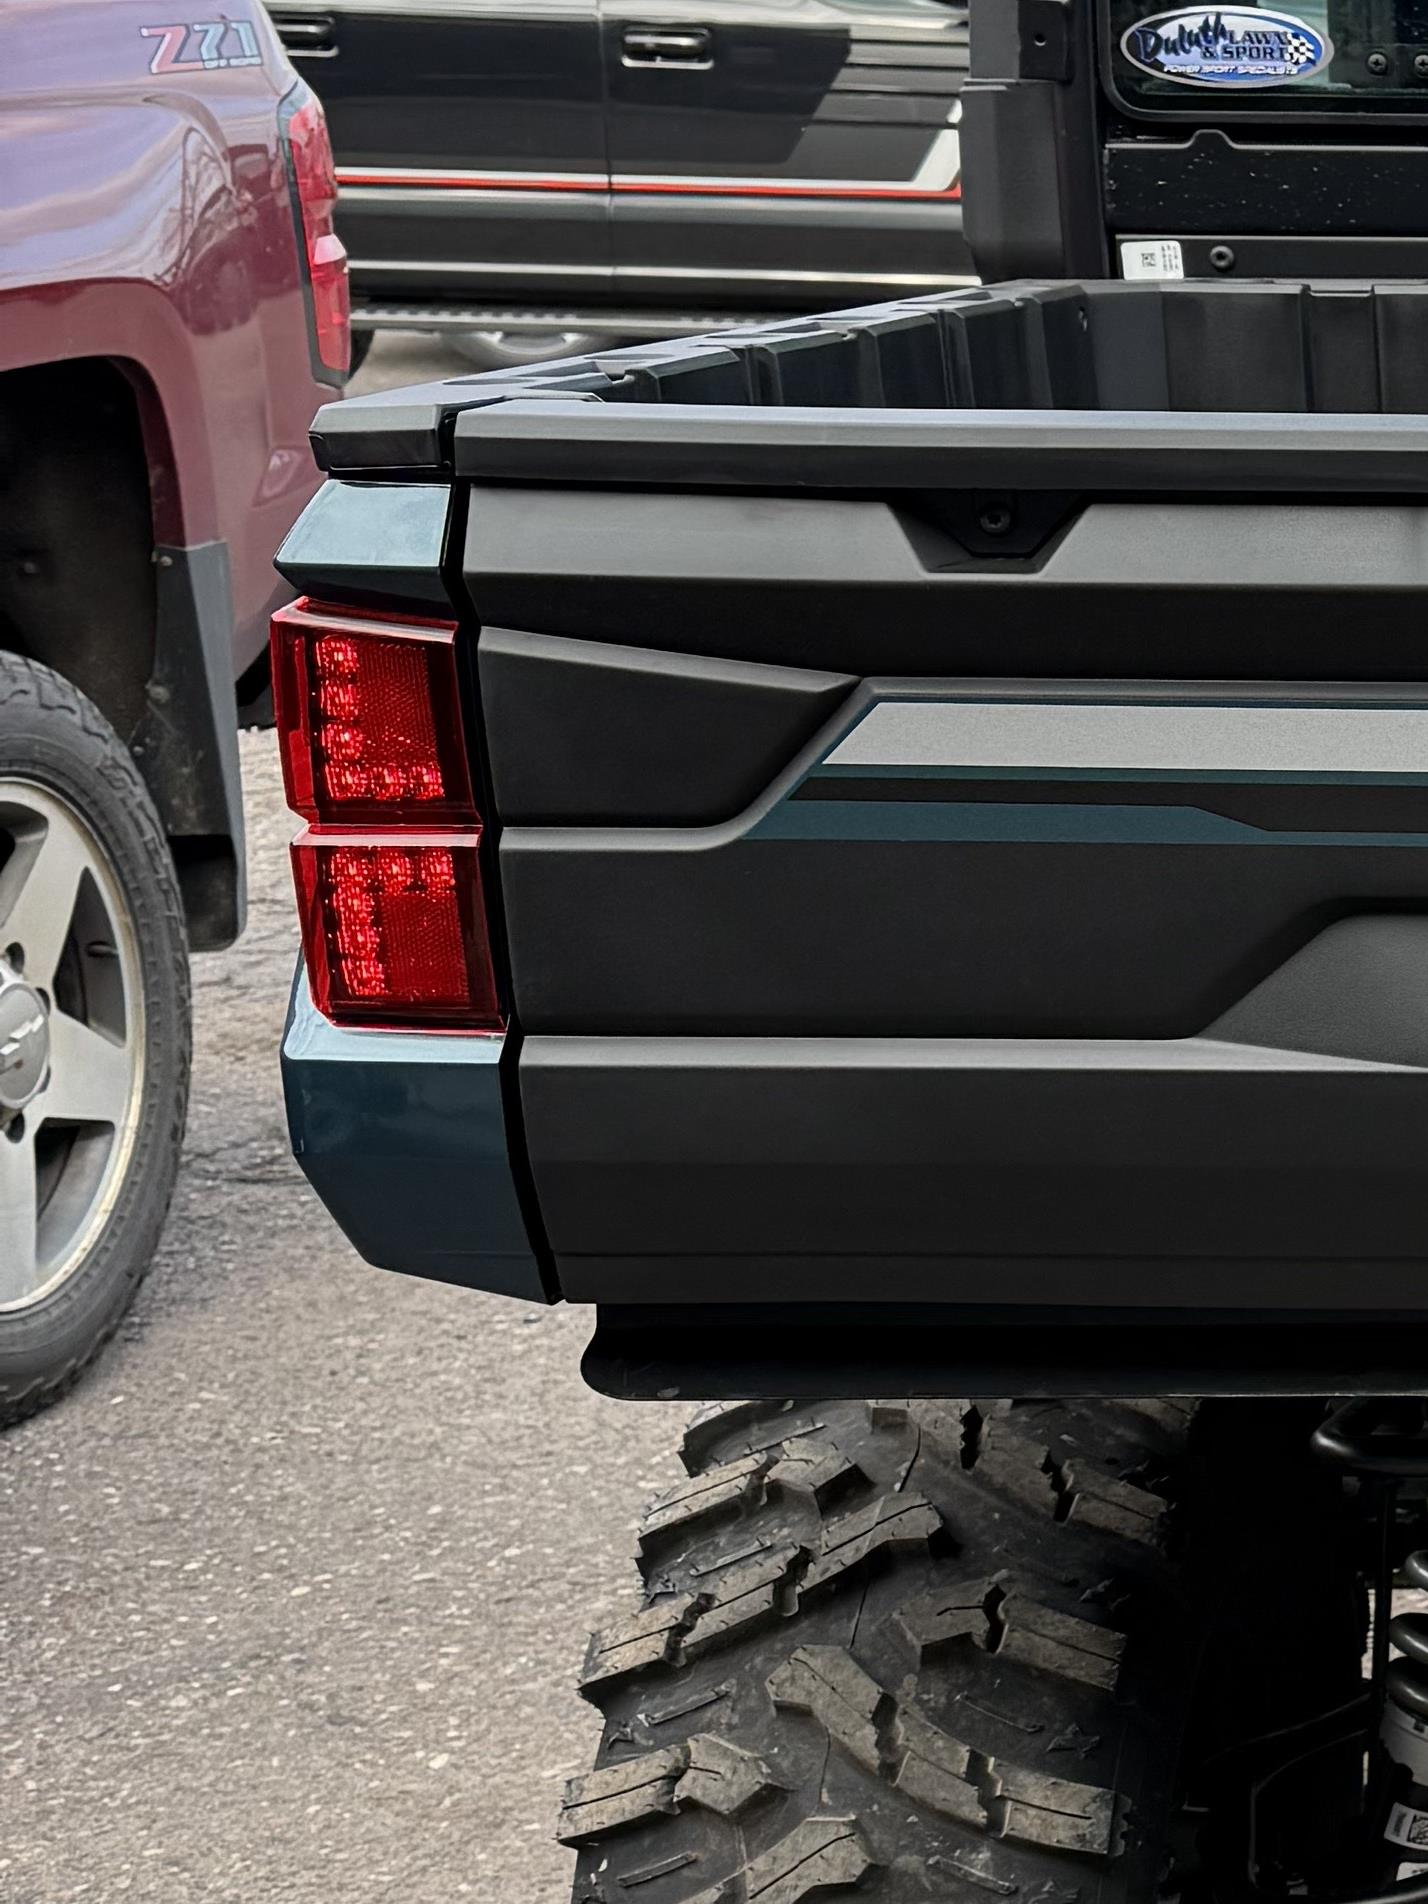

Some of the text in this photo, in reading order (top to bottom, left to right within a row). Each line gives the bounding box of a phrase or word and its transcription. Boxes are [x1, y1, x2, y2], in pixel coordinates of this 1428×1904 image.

[140, 20, 263, 74] Z71
[1134, 11, 1228, 63] Duluth
[1222, 45, 1287, 60] SPORT
[1228, 30, 1290, 46] LAWN
